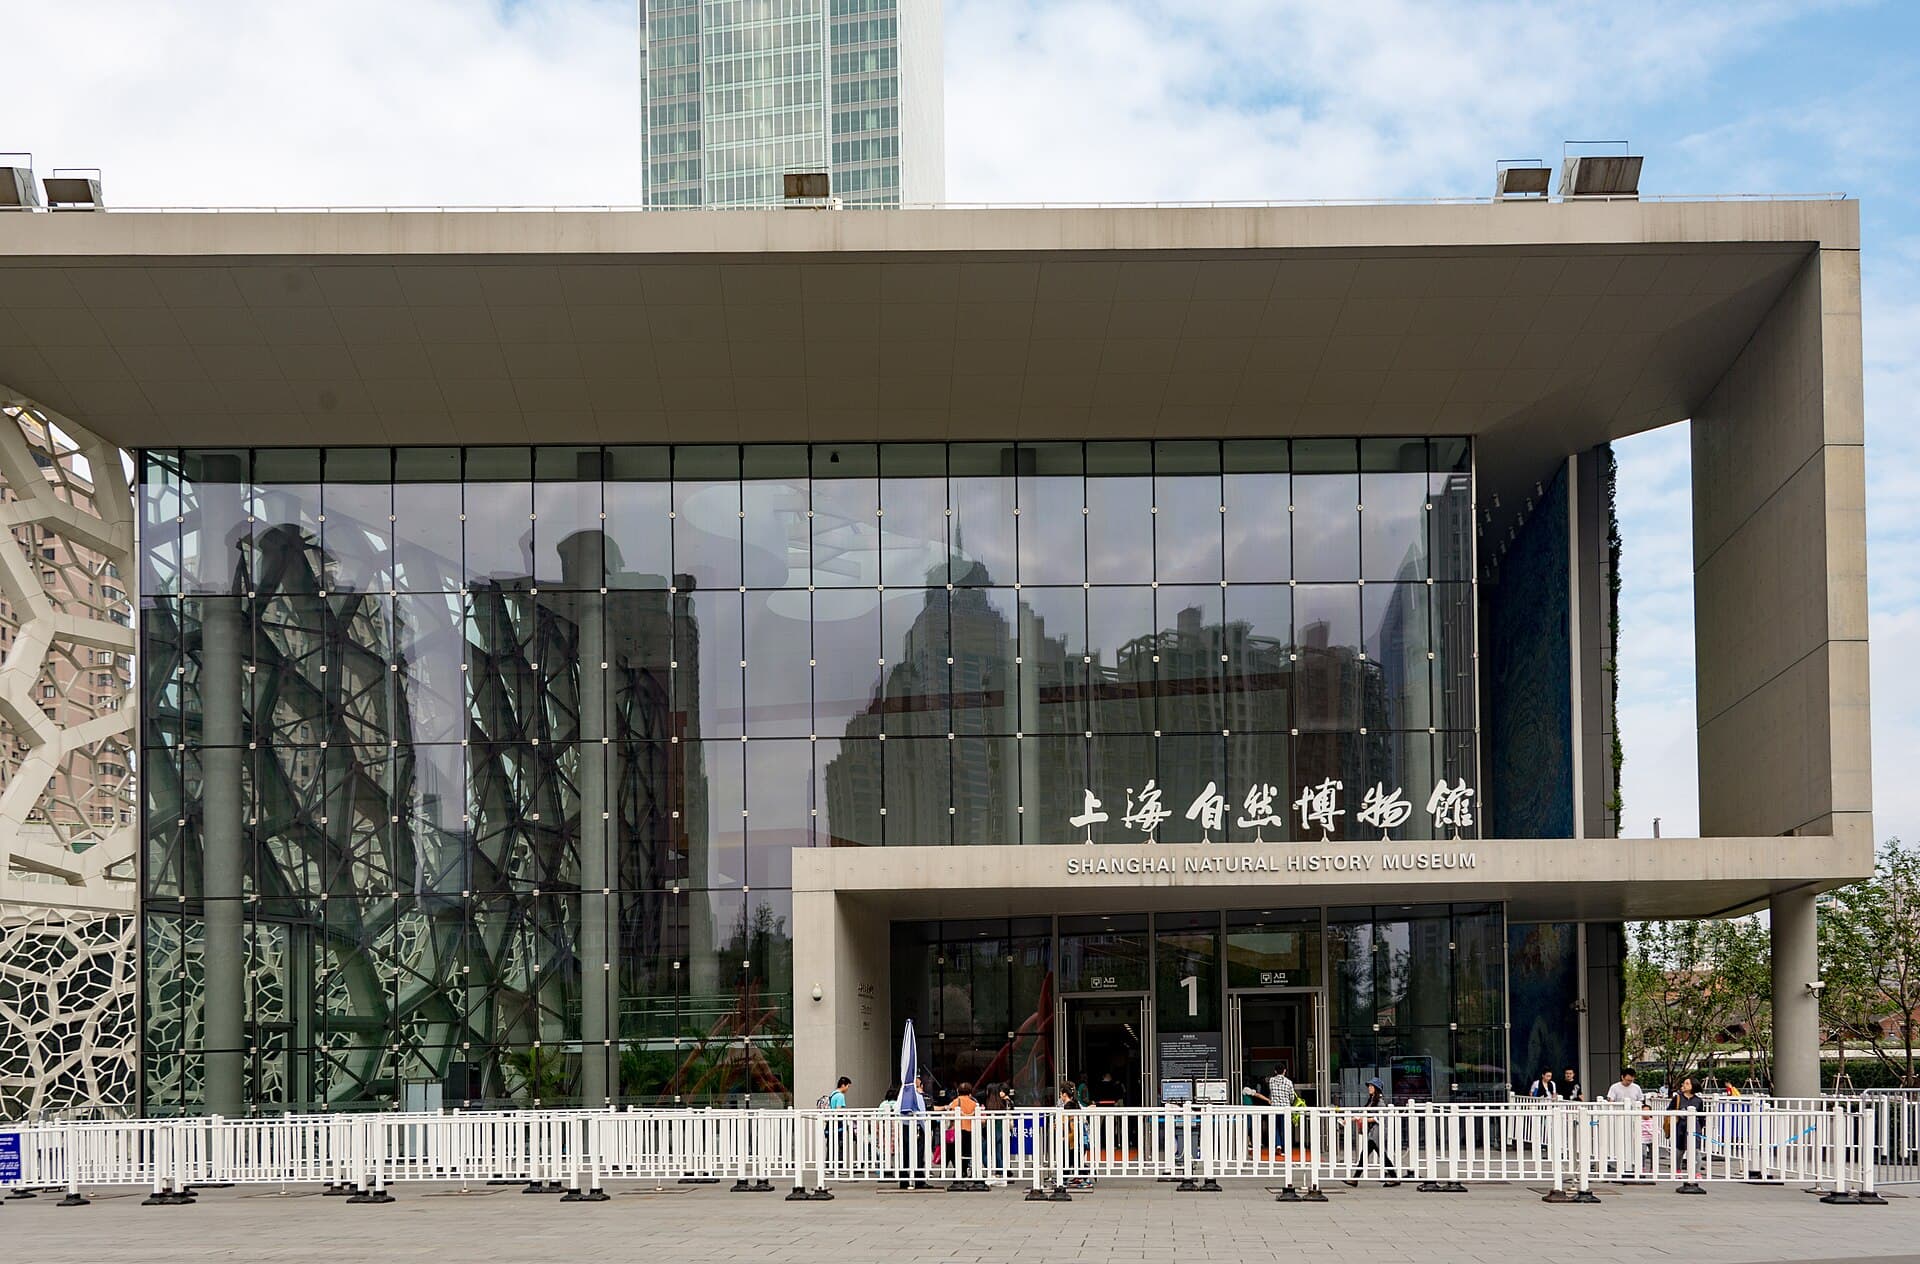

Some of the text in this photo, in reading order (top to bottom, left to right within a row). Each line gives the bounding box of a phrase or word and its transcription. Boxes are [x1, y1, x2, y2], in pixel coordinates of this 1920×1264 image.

[1067, 853, 1477, 875] SHANGHAI NATURAL HISTORY MUSEUM
[1180, 975, 1198, 1016] 1
